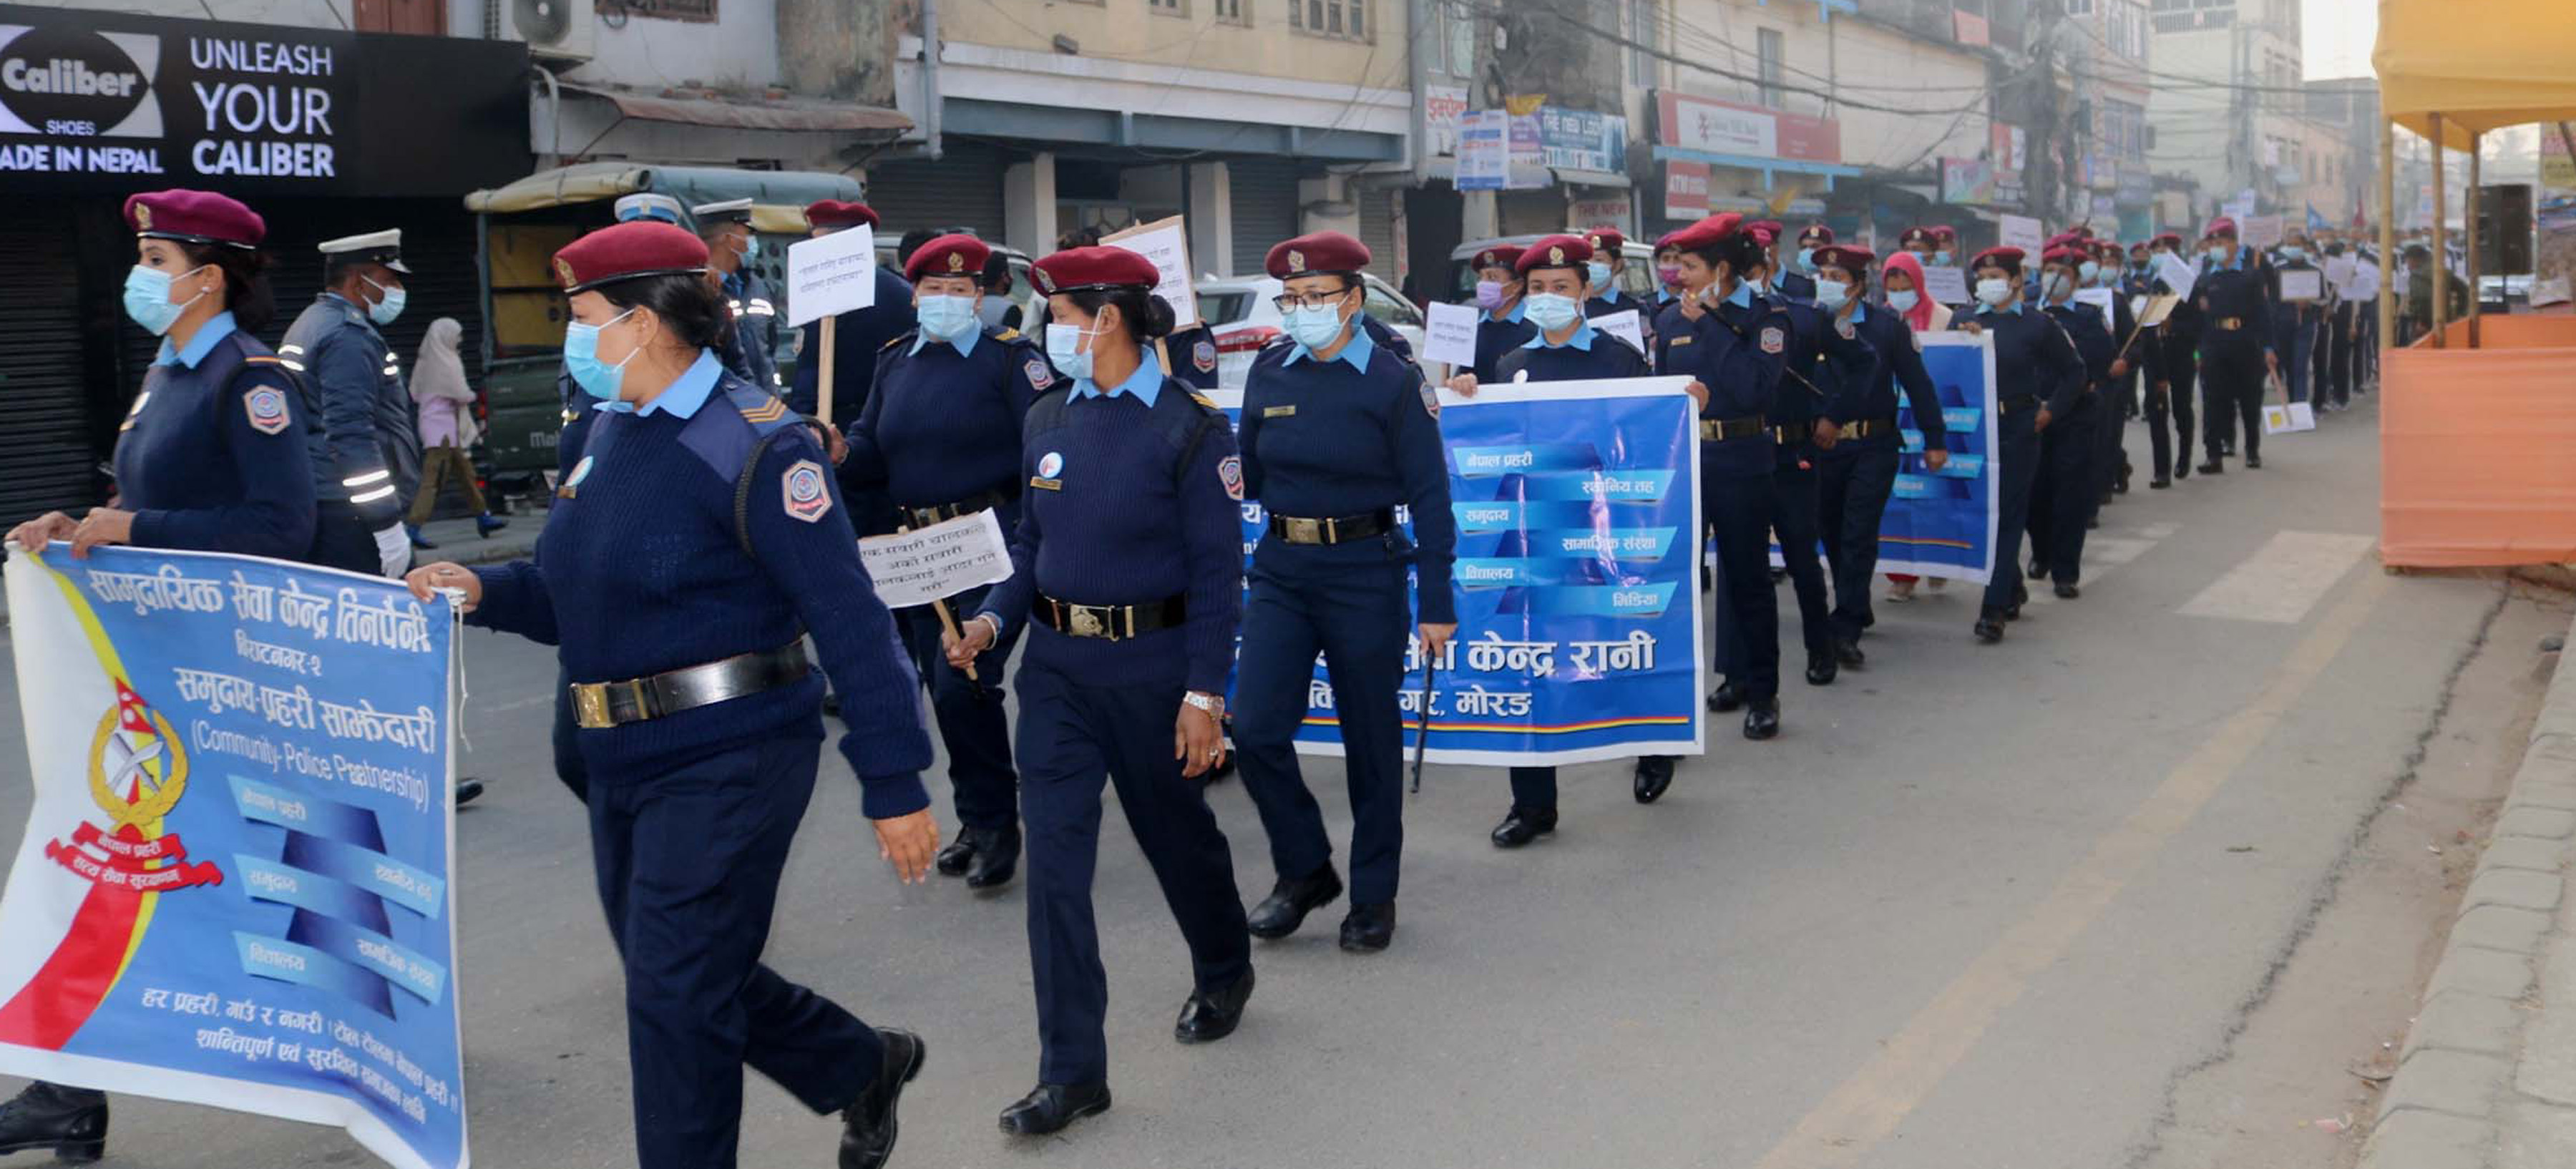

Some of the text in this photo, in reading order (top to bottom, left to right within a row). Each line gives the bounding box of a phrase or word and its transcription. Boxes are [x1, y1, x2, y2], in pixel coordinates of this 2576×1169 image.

[190, 37, 333, 77] UNLEASH
[2, 58, 137, 97] Caliber
[46, 119, 97, 136] SHOES
[192, 82, 333, 136] YOUR
[0, 144, 165, 174] ADE IN NEPAL
[192, 139, 336, 177] CALIBER
[87, 564, 223, 617] सामुदायिक
[230, 569, 273, 622] सेवा
[278, 577, 332, 640] केन्द्र
[1468, 630, 1558, 678] केन्द्र
[1569, 630, 1657, 673] रानी
[1455, 684, 1533, 716] मोरङ
[283, 741, 334, 781] Police
[141, 987, 169, 1009] हर
[260, 1006, 274, 1026] र
